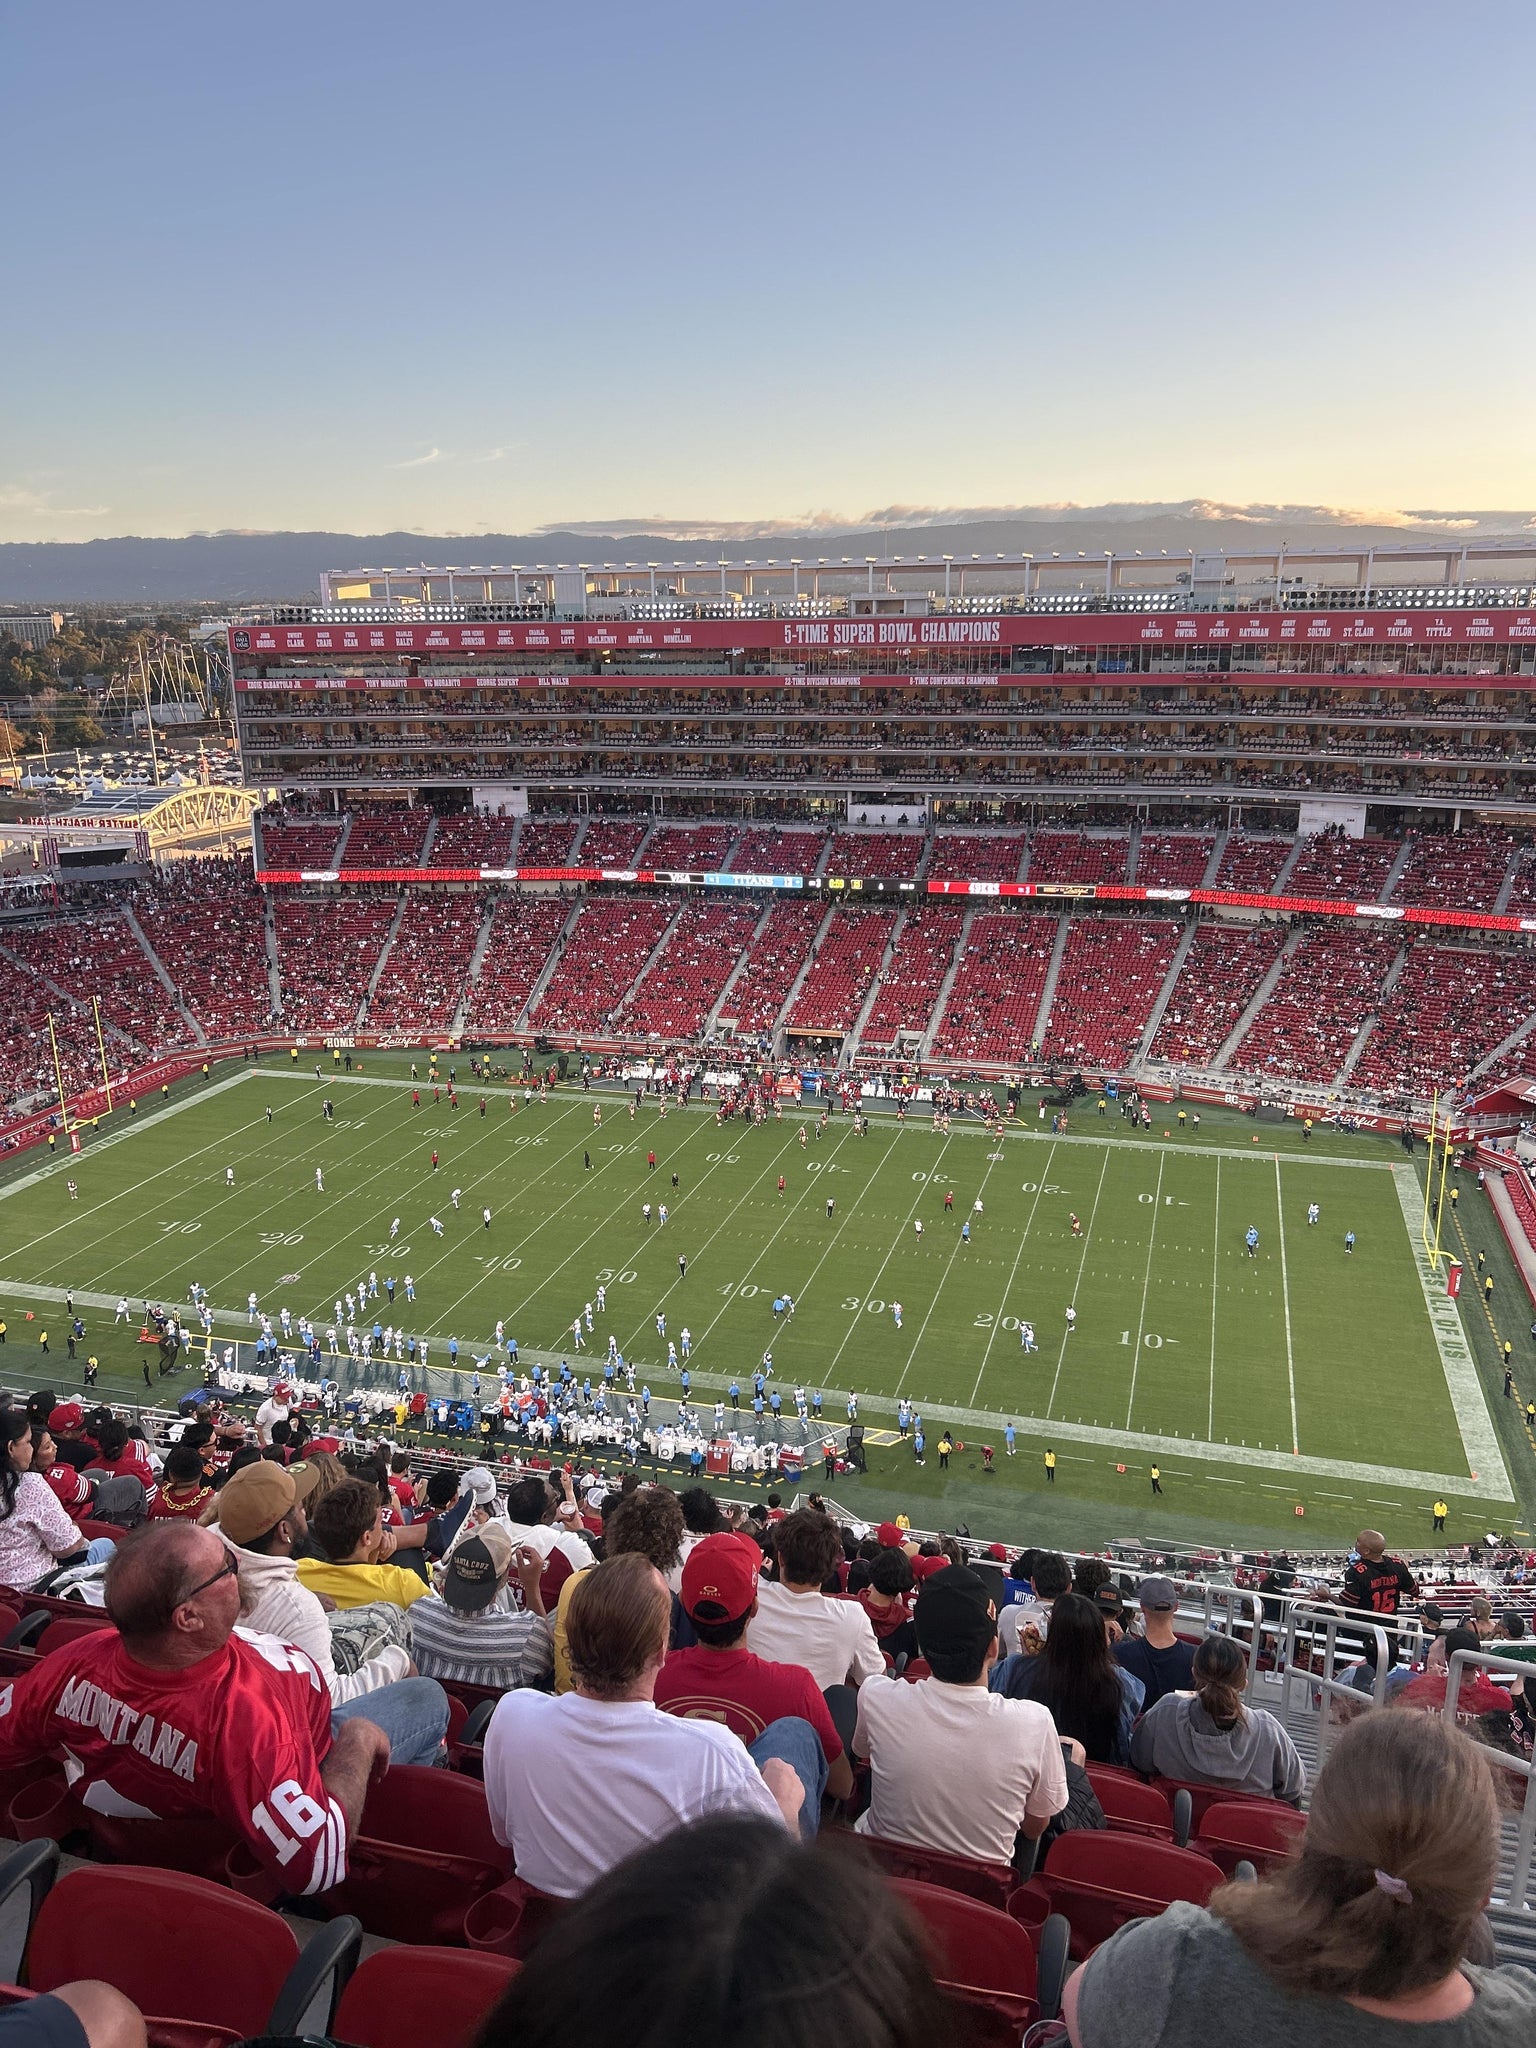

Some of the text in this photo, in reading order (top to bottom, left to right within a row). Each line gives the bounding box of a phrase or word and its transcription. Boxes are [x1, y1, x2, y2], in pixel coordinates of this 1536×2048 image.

[784, 621, 1000, 645] 5-TIME SUPER BOWL CHAMPIONS
[1141, 629, 1163, 638] OWENS
[1174, 628, 1197, 638] OWENS
[1208, 628, 1230, 637] PERRY
[1239, 628, 1270, 637] RATHMAN
[1280, 628, 1295, 637] RICE
[1307, 627, 1331, 637] SOLTAU
[1343, 627, 1374, 637] ST. CLAIR
[1387, 627, 1413, 637] TAYLOR
[1426, 627, 1452, 637] TITTLE
[1465, 627, 1494, 637] TURNER
[287, 639, 305, 647] CLARK
[316, 639, 332, 647] CRAIG
[344, 639, 358, 647] DEAN
[371, 638, 384, 646] GORE
[396, 638, 413, 646] HALEY
[425, 637, 449, 646] JOHNSON
[461, 637, 485, 646] JOHNSON
[497, 637, 514, 645] JONES
[560, 636, 575, 644] LOTT
[628, 635, 653, 644] MONTANA
[365, 680, 380, 688] TONY
[476, 678, 496, 687] GEORGE
[538, 677, 569, 685] BILL WALSH
[830, 676, 861, 685] CHAMPIONS
[929, 676, 965, 685] CONFERENCE
[966, 676, 998, 685] CHAMPIONS
[733, 876, 773, 886] TITANS
[968, 882, 999, 895] 49ERS
[326, 1037, 355, 1048] HOME
[376, 1035, 421, 1048] Faithful
[1307, 1109, 1321, 1118] THE
[261, 1232, 304, 1246] 20
[368, 1243, 411, 1258] 30
[595, 1268, 638, 1284] 50
[716, 1282, 759, 1298] 40
[841, 1296, 886, 1314] 30
[1428, 1290, 1453, 1313] ALL
[973, 1312, 1020, 1331] 20
[1436, 1319, 1460, 1336] OF
[1117, 1329, 1163, 1349] 10
[1441, 1341, 1467, 1360] US
[454, 1556, 490, 1570] SANTA CRUZ
[1371, 1588, 1397, 1613] 16
[55, 1674, 199, 1783] MONTANA
[251, 1778, 328, 1867] 16
